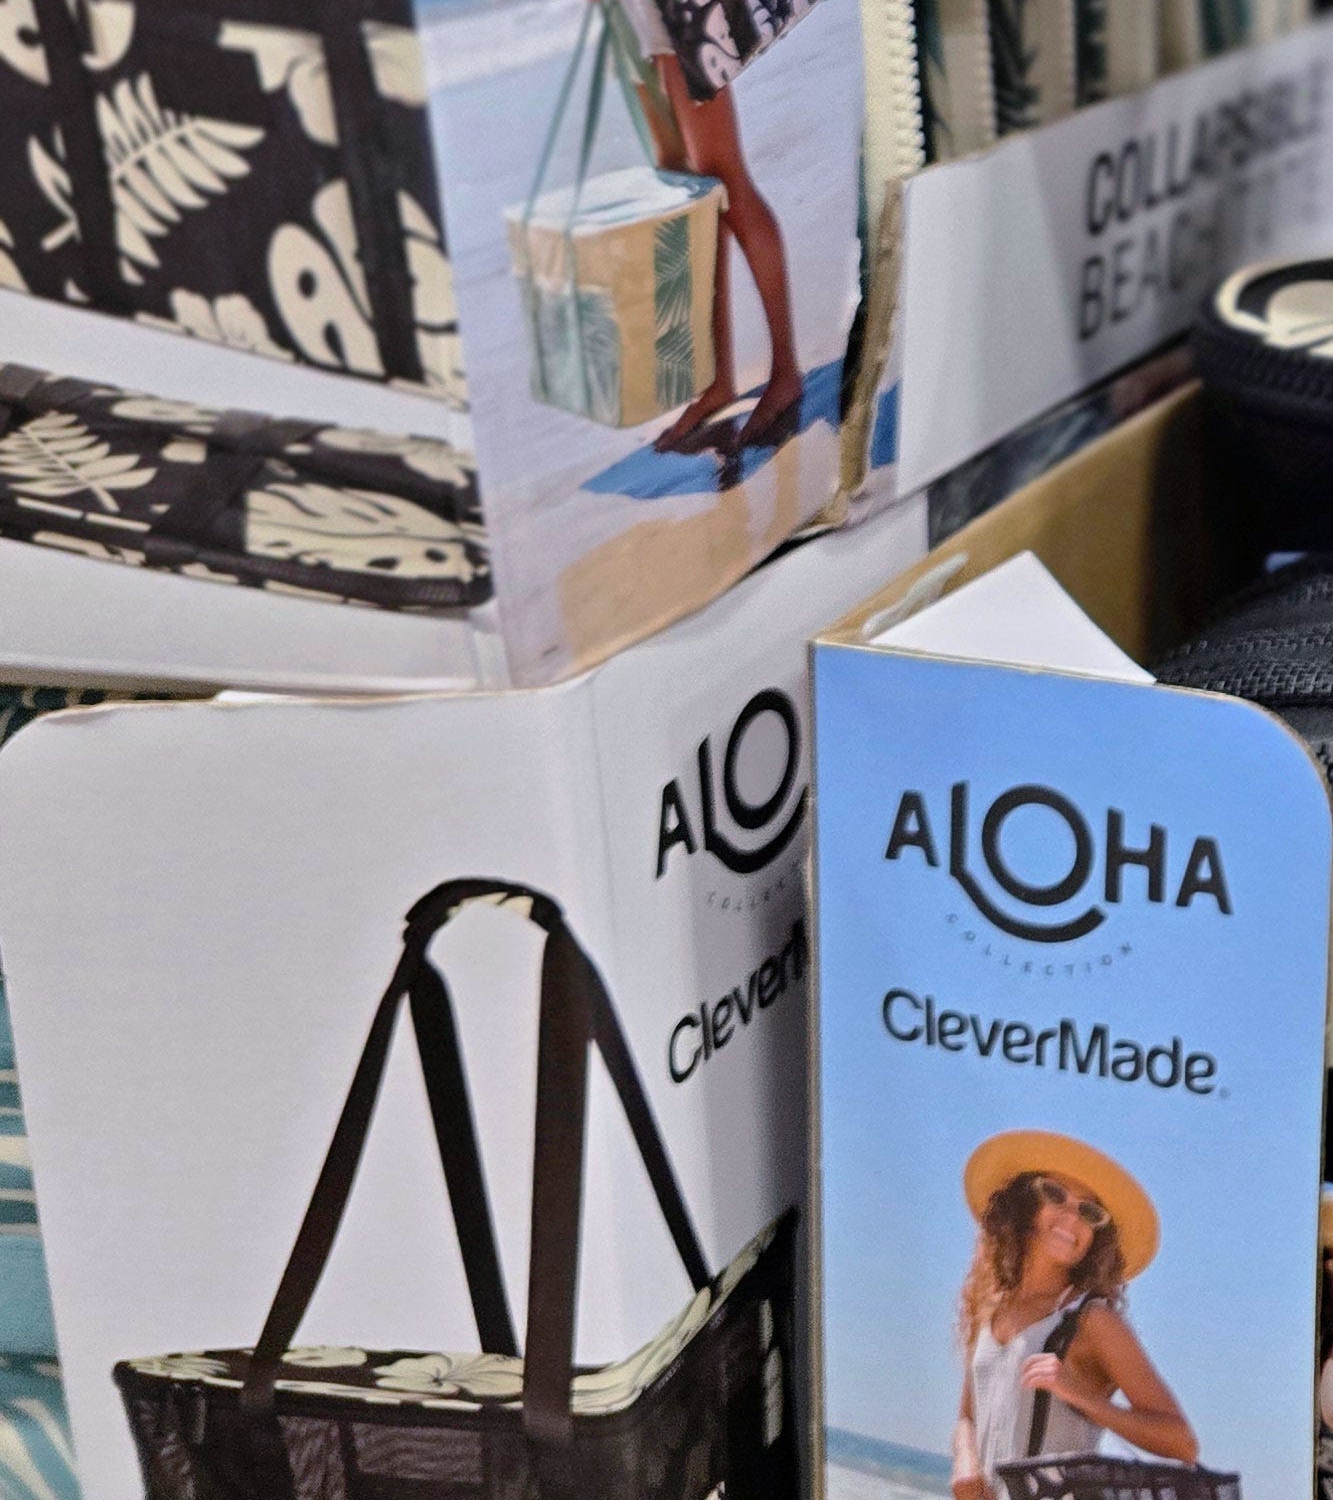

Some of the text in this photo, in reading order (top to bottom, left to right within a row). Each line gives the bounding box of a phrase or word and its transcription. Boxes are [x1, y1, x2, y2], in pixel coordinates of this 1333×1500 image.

[655, 687, 810, 879] ALO
[884, 780, 1233, 943] ALOHA
[947, 911, 1133, 976] COLLECTION
[881, 987, 1218, 1095] CleverMade
